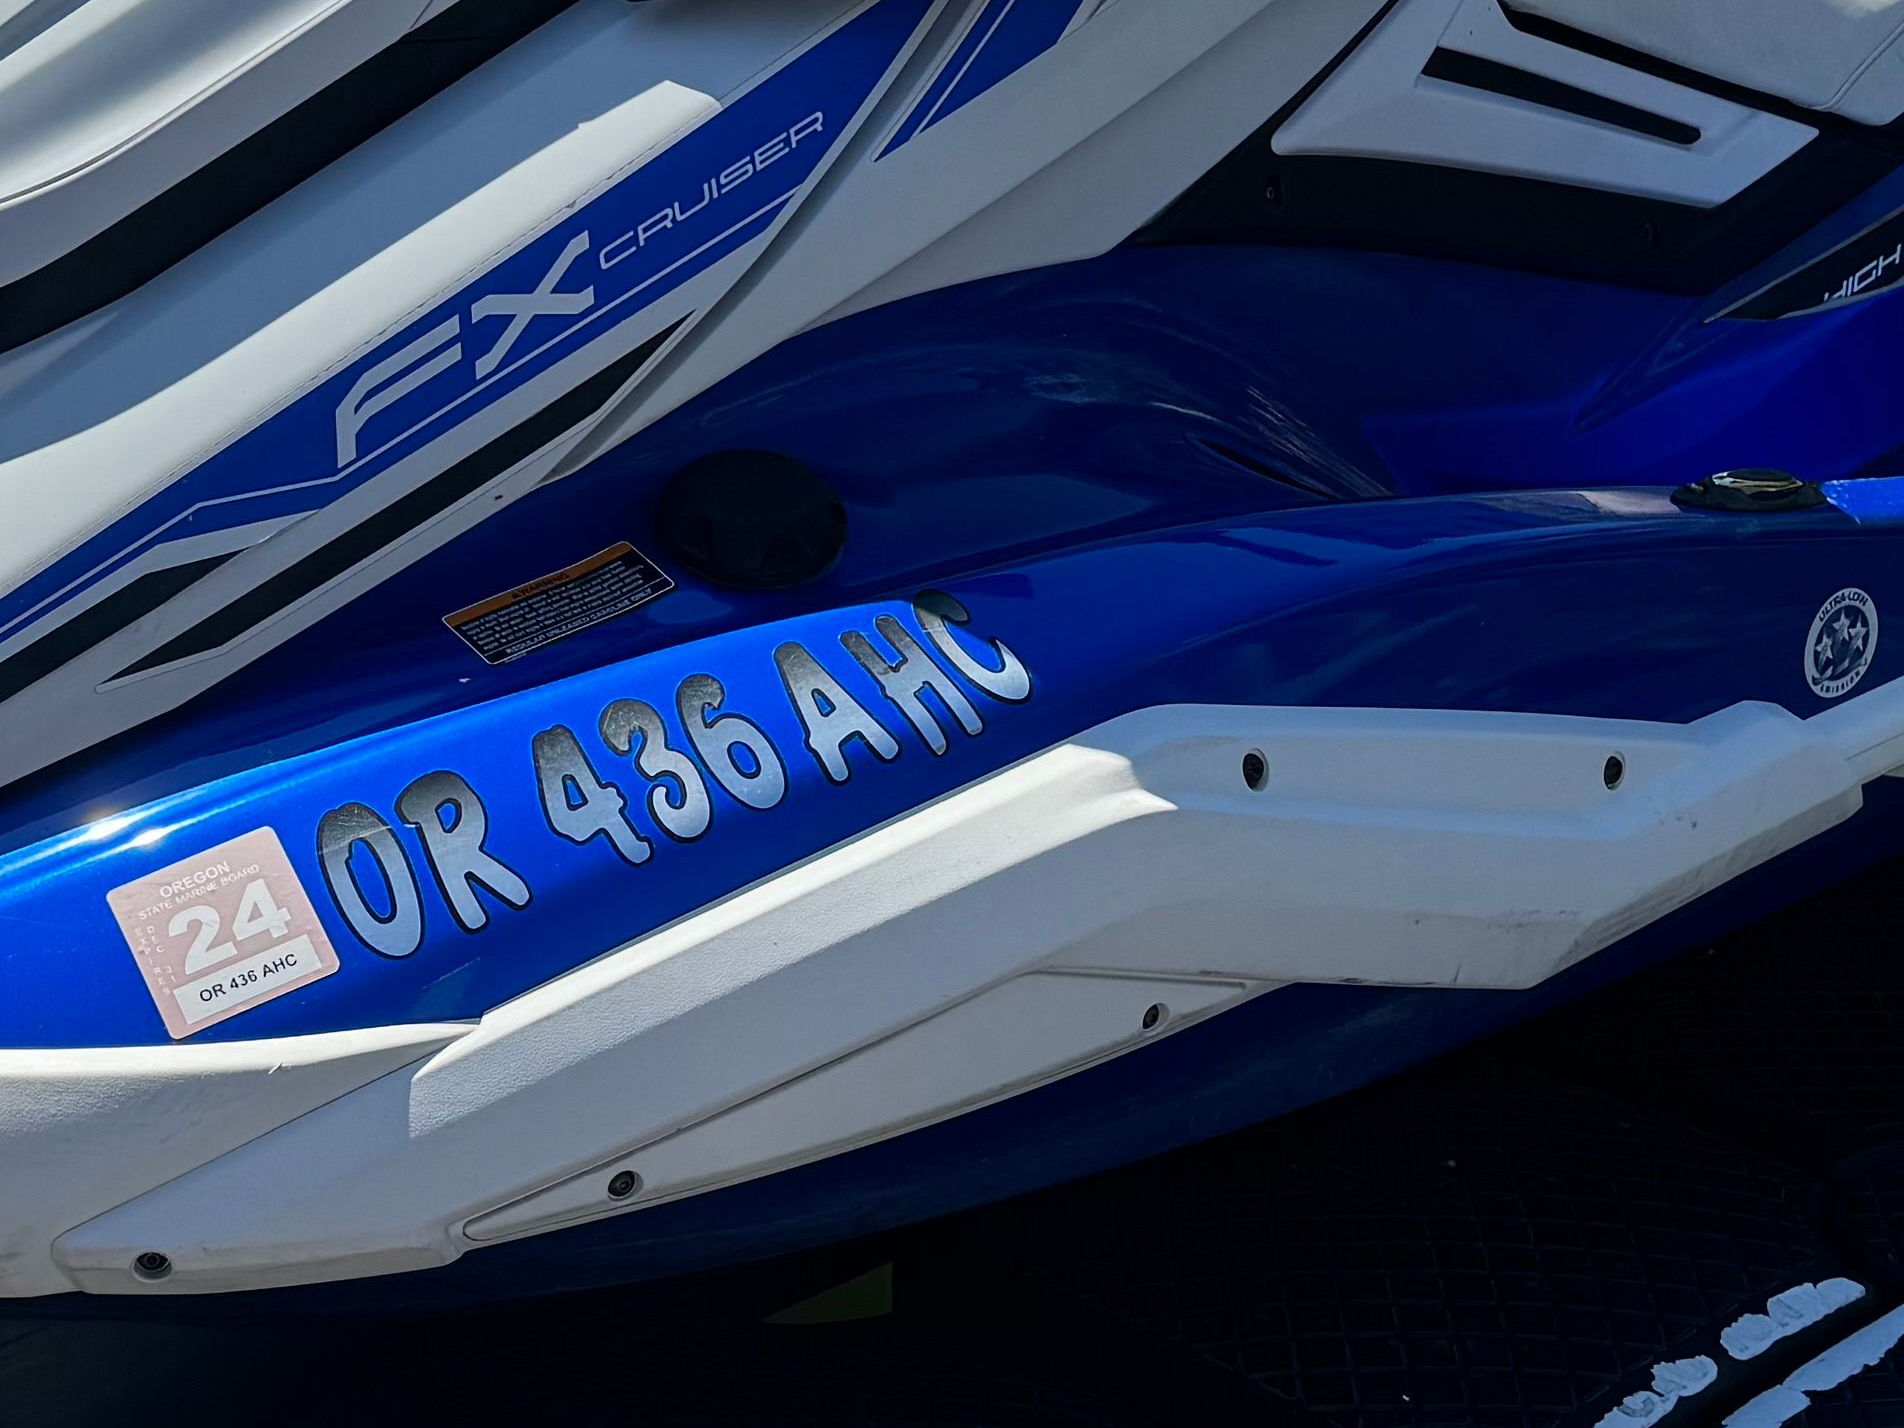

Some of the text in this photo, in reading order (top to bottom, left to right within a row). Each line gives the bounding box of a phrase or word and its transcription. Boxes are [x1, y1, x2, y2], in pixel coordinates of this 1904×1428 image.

[335, 111, 824, 468] FX CRUISER
[317, 770, 534, 959] OR
[532, 673, 790, 866] 436
[773, 589, 1033, 784] AHC
[138, 863, 260, 921] STATE MARINE BOARD
[159, 860, 232, 899] OREGON
[167, 877, 292, 976] 24
[199, 953, 298, 1003] OR 436 AHC
